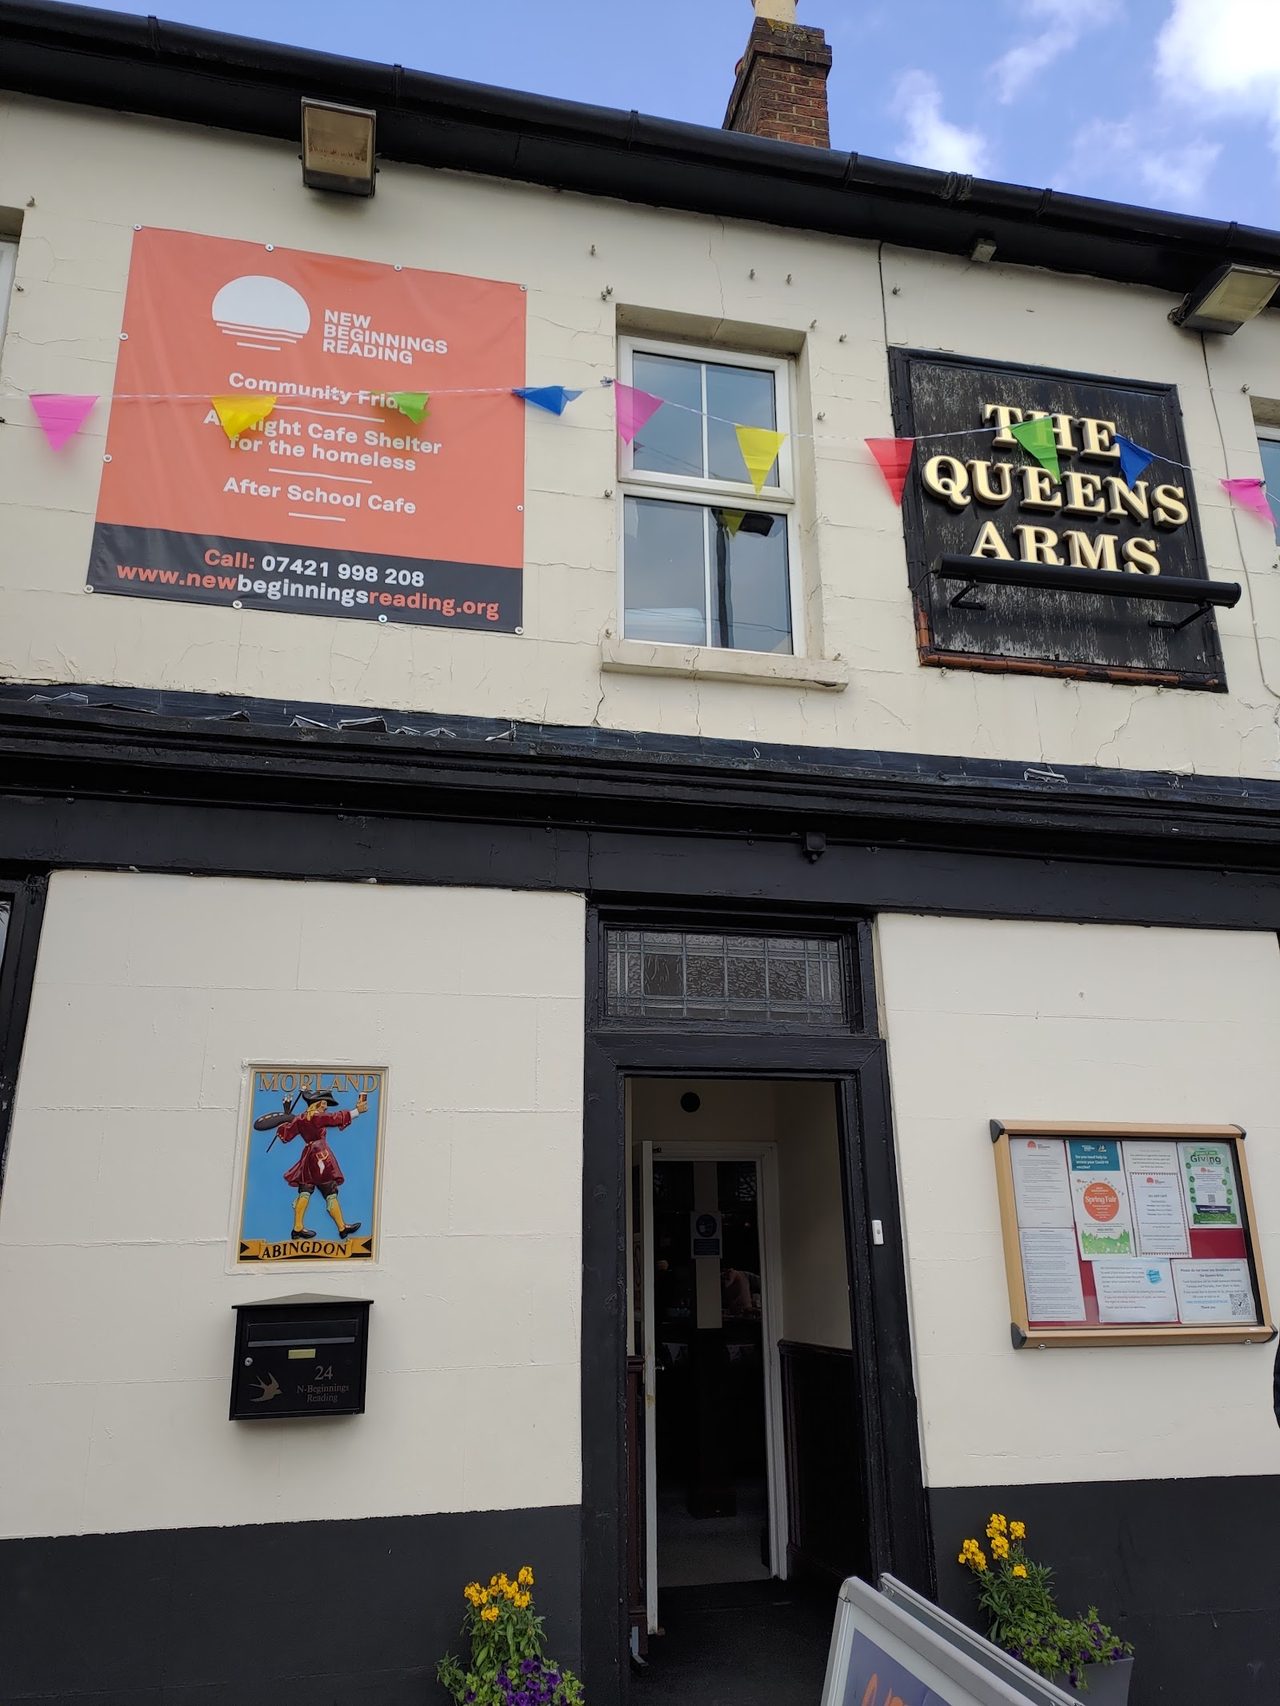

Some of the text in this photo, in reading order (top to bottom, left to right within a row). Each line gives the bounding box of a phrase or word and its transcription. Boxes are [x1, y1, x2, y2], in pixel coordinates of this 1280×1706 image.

[324, 309, 371, 329] NEW
[322, 338, 413, 364] READING
[323, 323, 448, 354] BEGINNINGS
[229, 372, 404, 410] Community Frid
[307, 423, 358, 443] Cafe
[364, 430, 442, 454] Shelter
[982, 403, 1121, 459] THE
[229, 435, 416, 471] for the homeless
[223, 476, 416, 514] After School Cafe
[922, 455, 1189, 528] QUEENS
[969, 520, 1161, 576] ARMS
[203, 548, 425, 587] Call: 07421 998 208
[116, 564, 500, 621] www.newbeginningsreading.org
[259, 1072, 379, 1093] MORLAND
[261, 1238, 348, 1259] ABINGDON
[314, 1365, 334, 1380] 24
[306, 1392, 338, 1403] Reading
